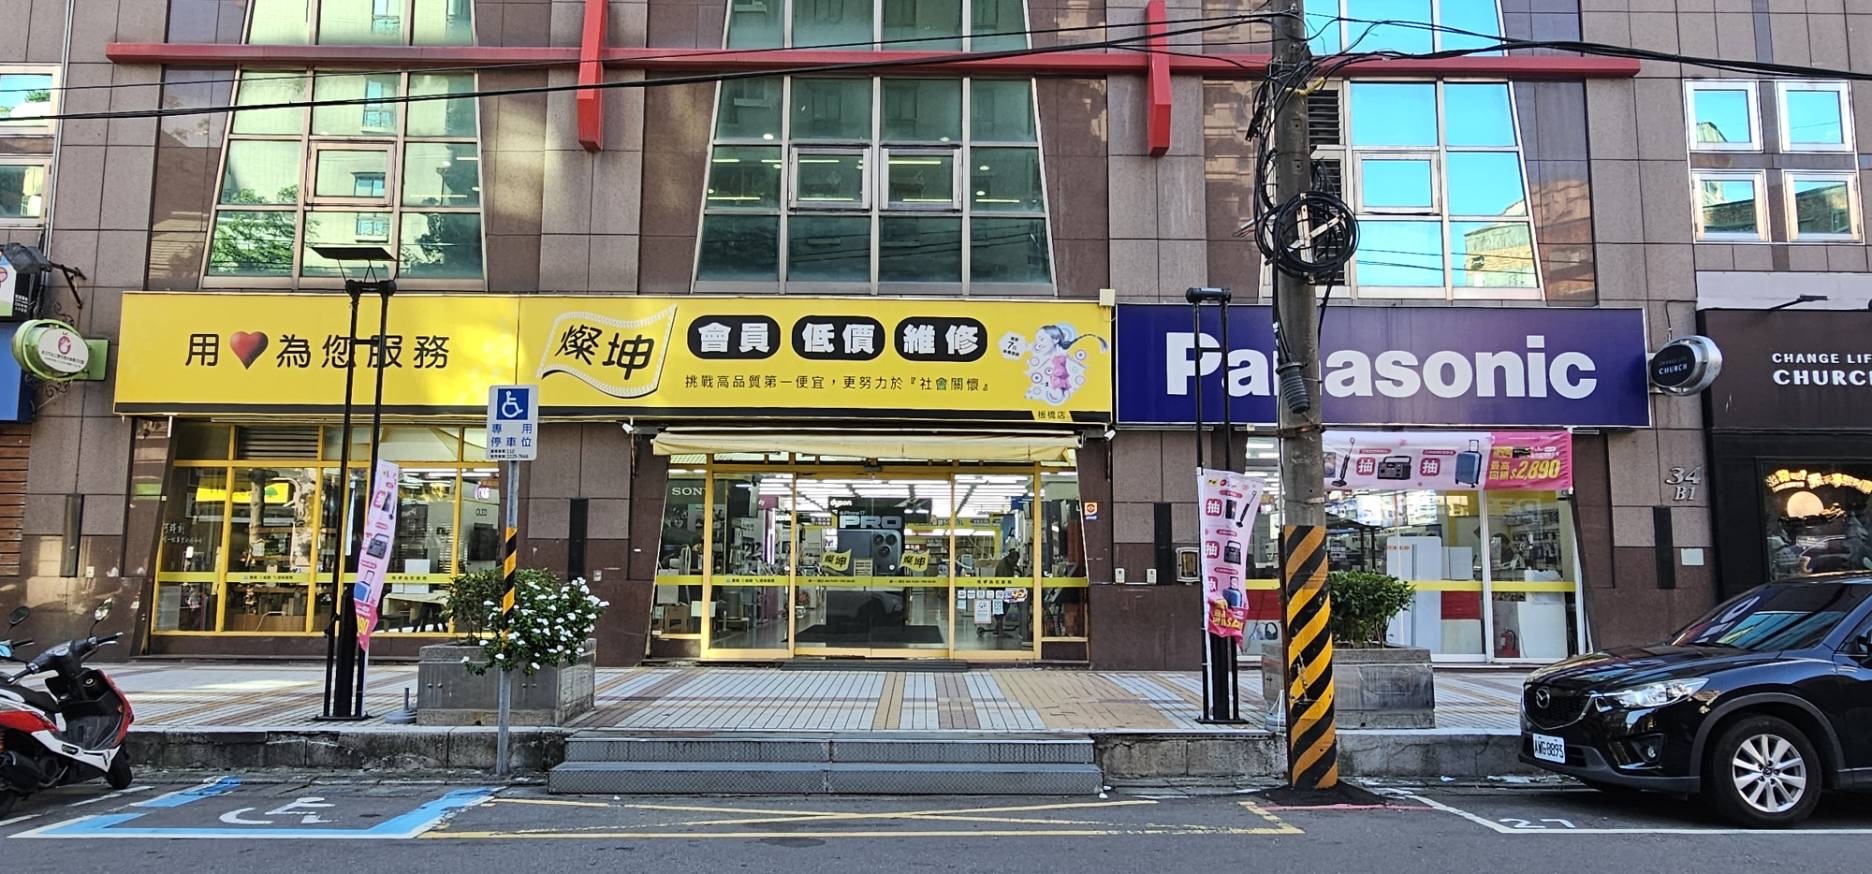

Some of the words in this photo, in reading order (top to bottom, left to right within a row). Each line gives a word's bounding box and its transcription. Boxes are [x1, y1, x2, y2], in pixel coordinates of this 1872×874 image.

[697, 322, 771, 353] 會員
[801, 322, 875, 354] 低價
[903, 323, 979, 356] 維修
[555, 324, 654, 380] 燦坤
[1772, 353, 1839, 364] CHANGE
[1165, 332, 1597, 400] Paasonic
[1658, 363, 1688, 375] CHURCH
[1773, 370, 1872, 386] CHURC
[491, 437, 532, 447] 停車位
[1358, 460, 1374, 473] 抽
[1423, 460, 1438, 474] 抽
[1510, 460, 1561, 480] $2,890
[1665, 467, 1702, 485] 34
[672, 487, 705, 496] SON
[1674, 487, 1696, 501] B1
[1207, 500, 1221, 514] 抽
[840, 515, 900, 529] PRO
[1499, 818, 1576, 828] 27
